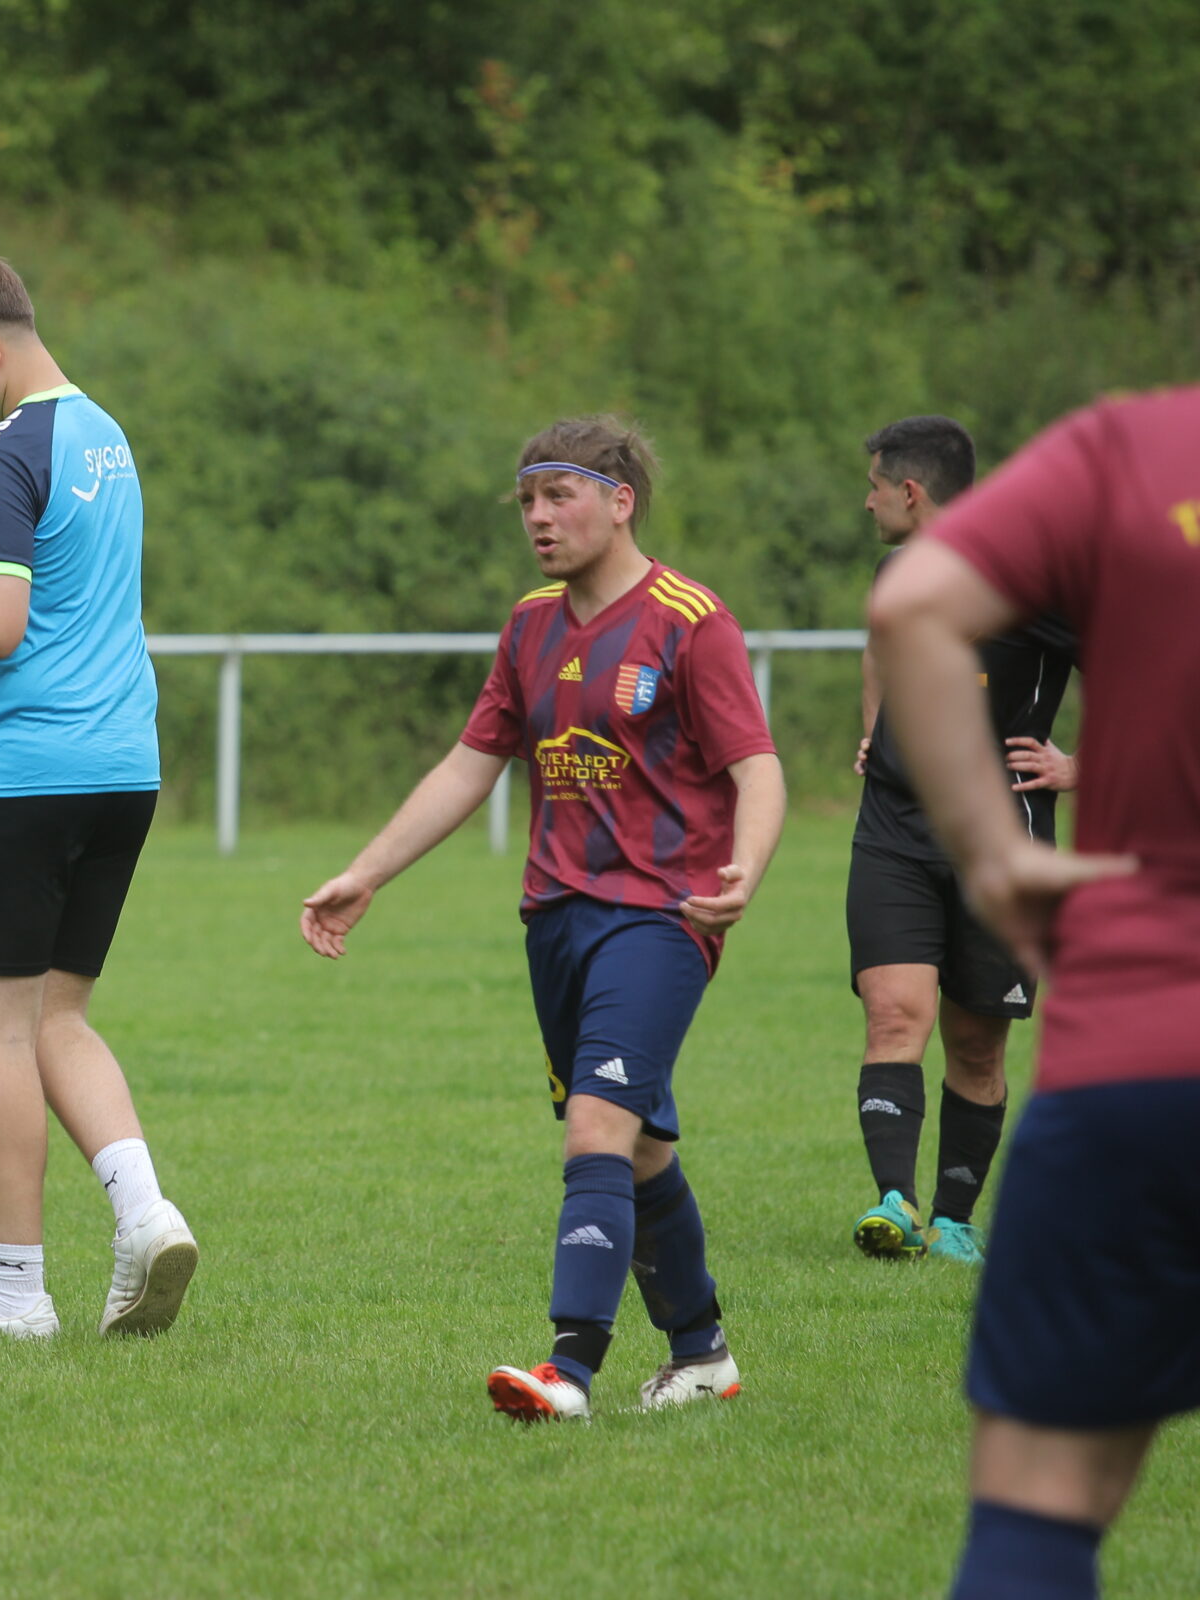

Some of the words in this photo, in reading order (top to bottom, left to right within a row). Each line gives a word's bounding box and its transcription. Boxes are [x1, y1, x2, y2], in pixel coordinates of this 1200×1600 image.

[594, 1067, 629, 1085] adidas
[861, 1102, 902, 1116] adidas
[561, 1236, 614, 1249] adidas
